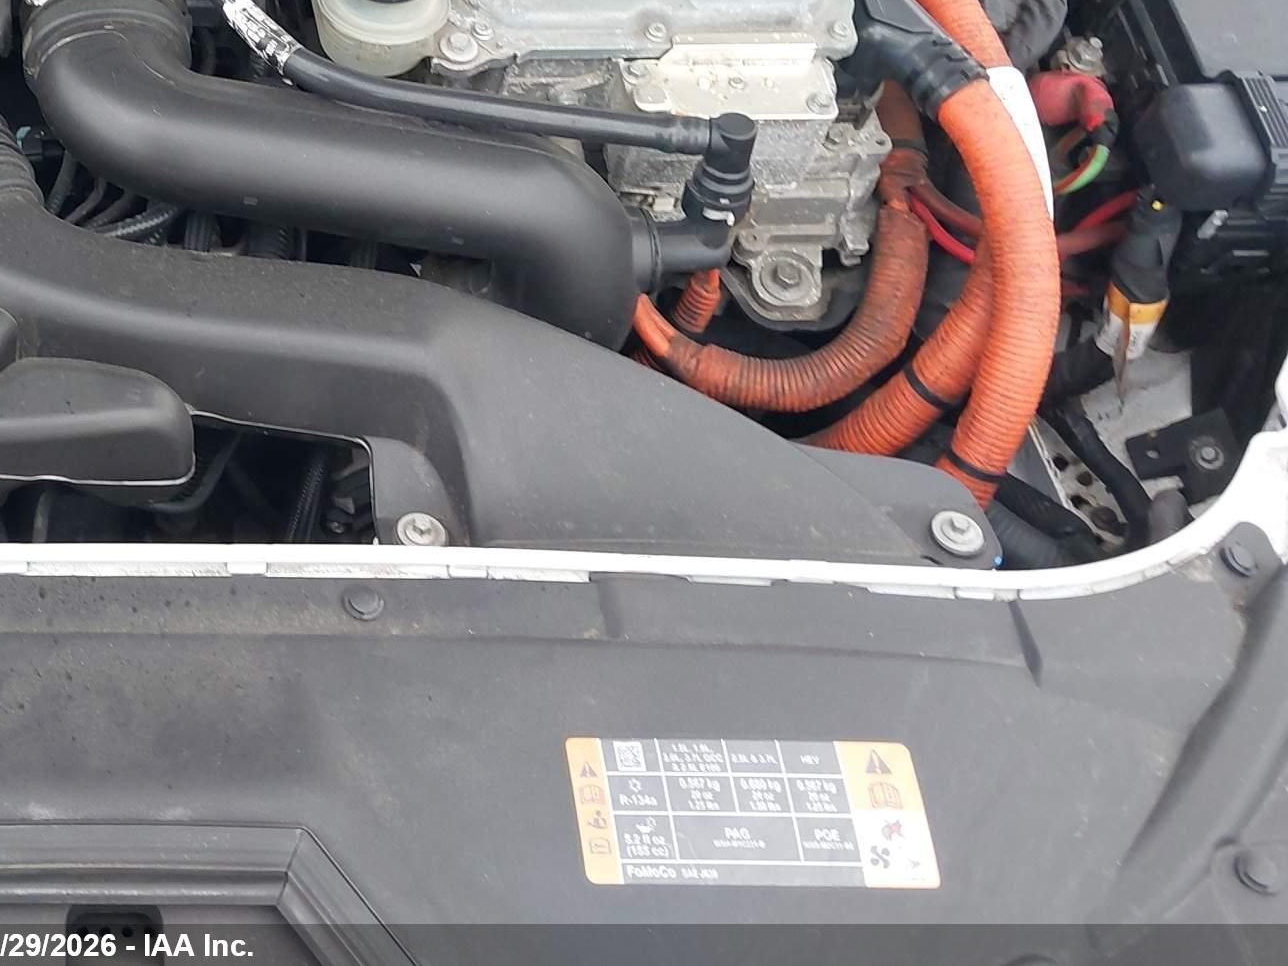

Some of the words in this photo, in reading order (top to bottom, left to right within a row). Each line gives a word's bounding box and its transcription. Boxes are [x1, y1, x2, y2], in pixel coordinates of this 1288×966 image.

[619, 793, 658, 806] R-134a
[724, 827, 751, 840] PAG
[814, 828, 841, 842] POE
[627, 865, 677, 879] FoMoCo
